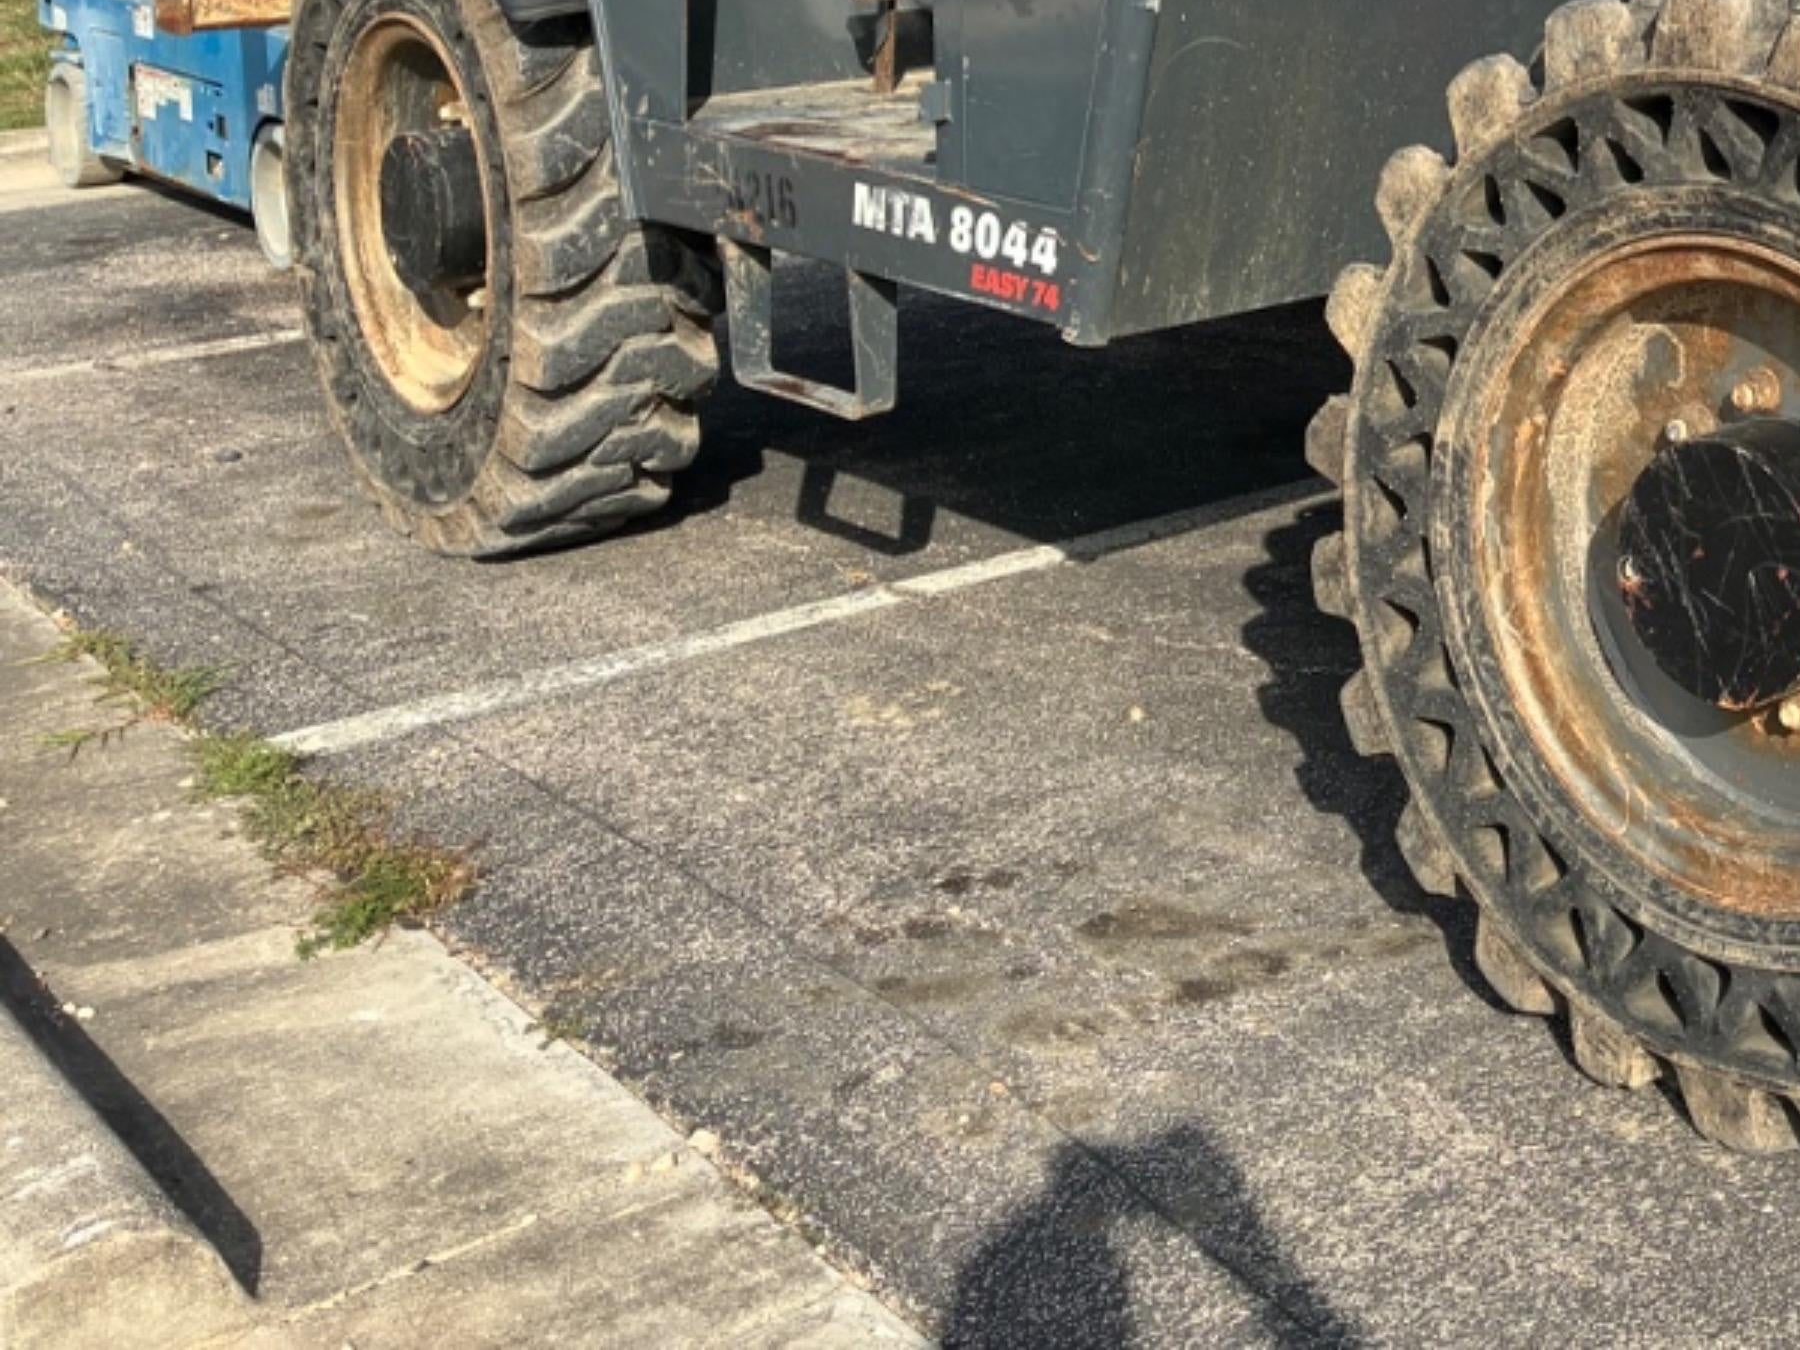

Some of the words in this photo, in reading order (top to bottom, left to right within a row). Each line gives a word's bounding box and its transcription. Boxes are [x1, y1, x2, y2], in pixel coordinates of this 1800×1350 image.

[852, 181, 937, 244] MTA
[950, 205, 1058, 275] 8044
[971, 262, 1029, 301] EASY
[1032, 281, 1061, 312] 74
